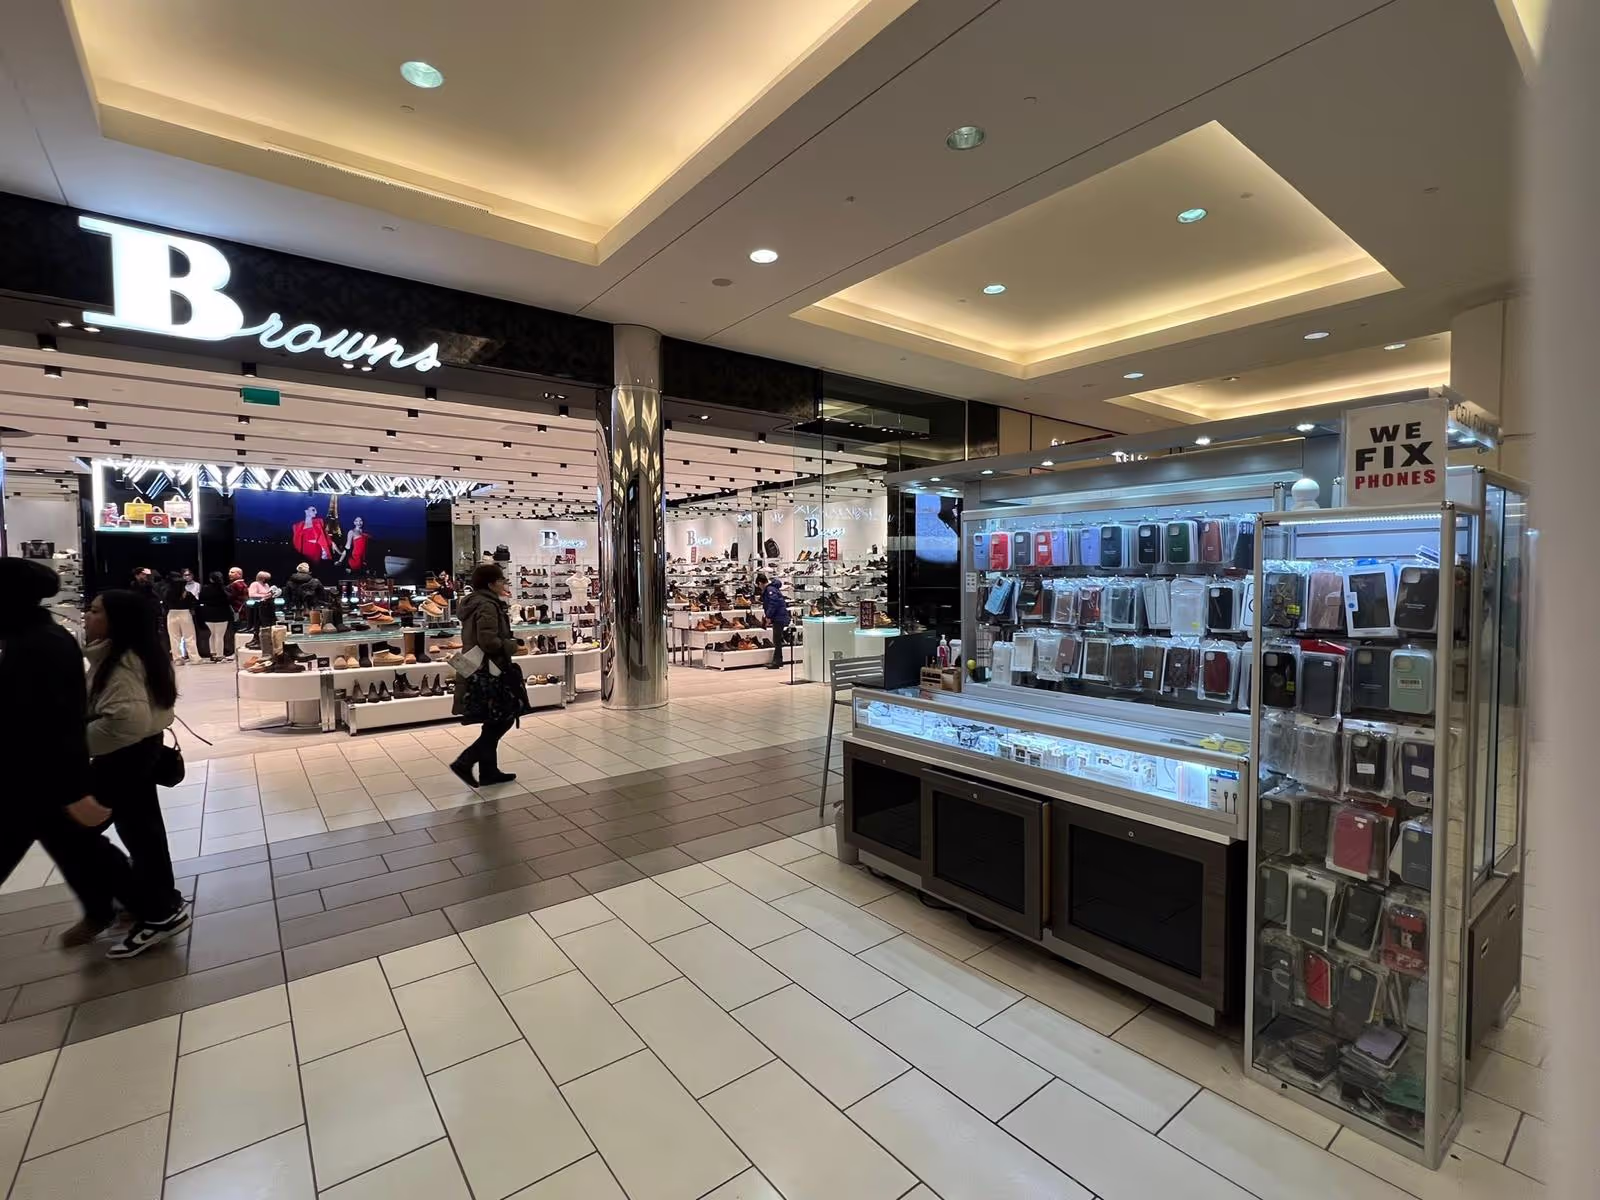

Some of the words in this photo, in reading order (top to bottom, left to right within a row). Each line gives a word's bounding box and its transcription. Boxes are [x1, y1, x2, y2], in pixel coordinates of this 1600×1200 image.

[78, 215, 442, 373] Browns
[1369, 421, 1422, 444] WE
[1355, 441, 1434, 472] FIX
[1355, 469, 1436, 490] PHONES
